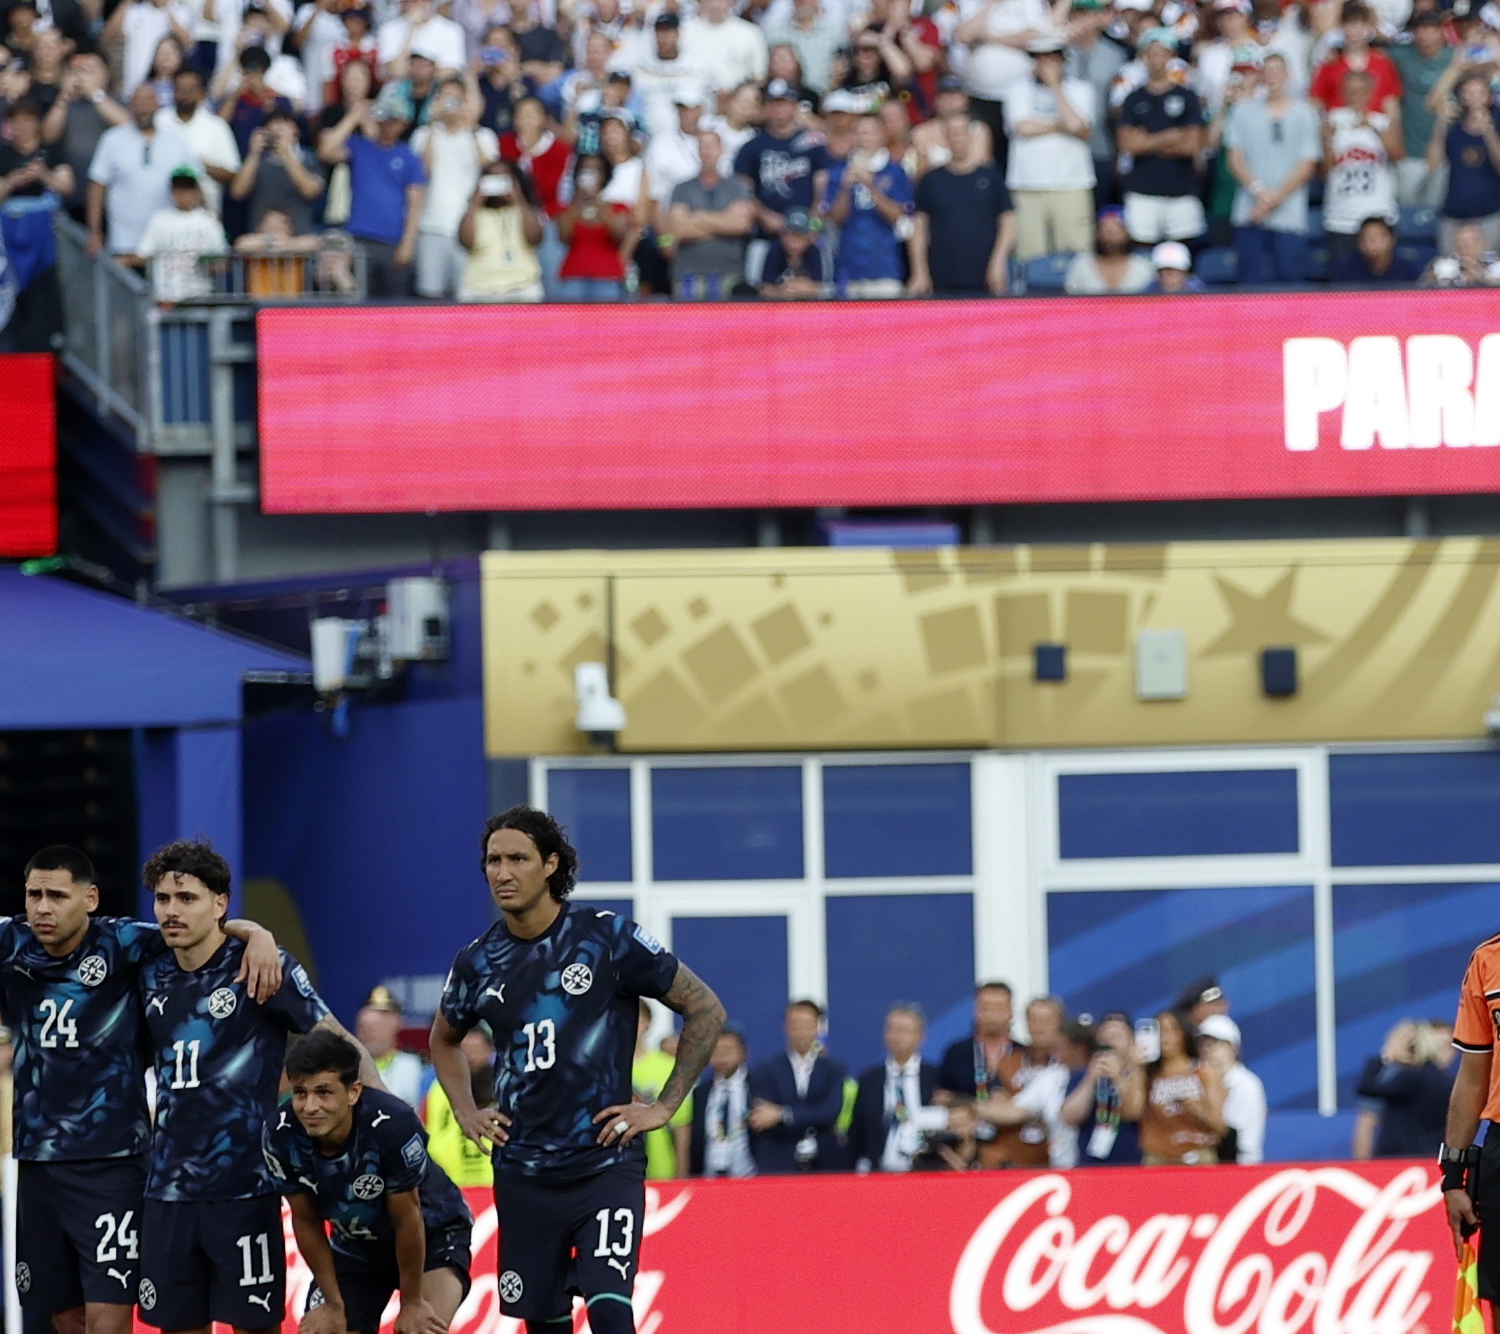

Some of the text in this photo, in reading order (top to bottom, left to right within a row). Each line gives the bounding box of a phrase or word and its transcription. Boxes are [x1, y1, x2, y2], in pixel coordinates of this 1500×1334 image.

[39, 998, 79, 1050] 24
[522, 1018, 558, 1073] 13
[172, 1038, 202, 1090] 11
[96, 1209, 139, 1264] 24
[236, 1232, 276, 1287] 11
[594, 1207, 635, 1259] 13
